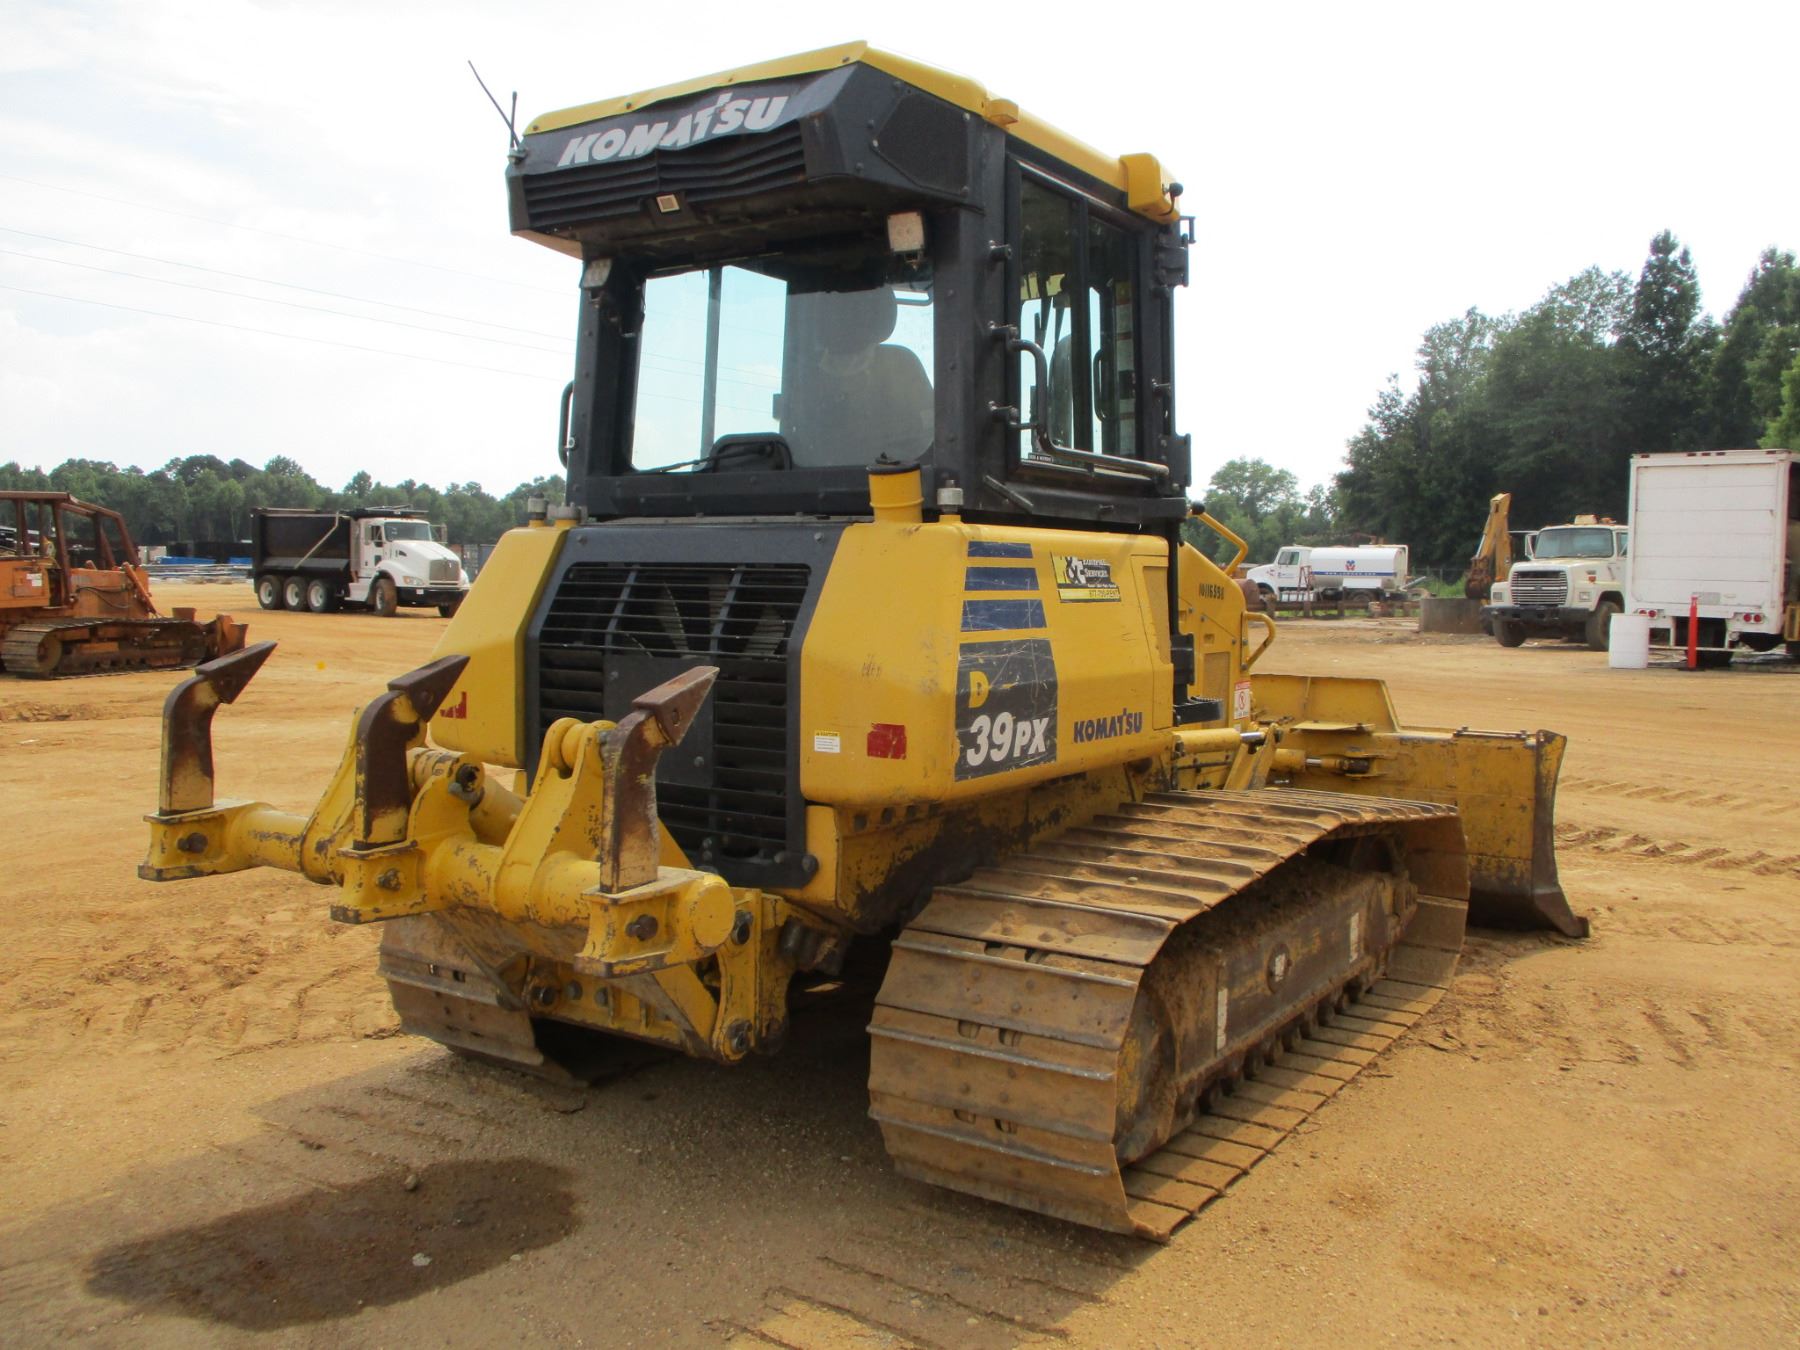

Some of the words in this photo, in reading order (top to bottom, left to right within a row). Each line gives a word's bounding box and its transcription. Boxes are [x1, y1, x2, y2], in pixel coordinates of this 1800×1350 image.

[557, 91, 788, 167] KOMATSU
[968, 670, 989, 709] D
[966, 711, 1049, 767] 39PX
[1073, 707, 1143, 744] KOMATSU
